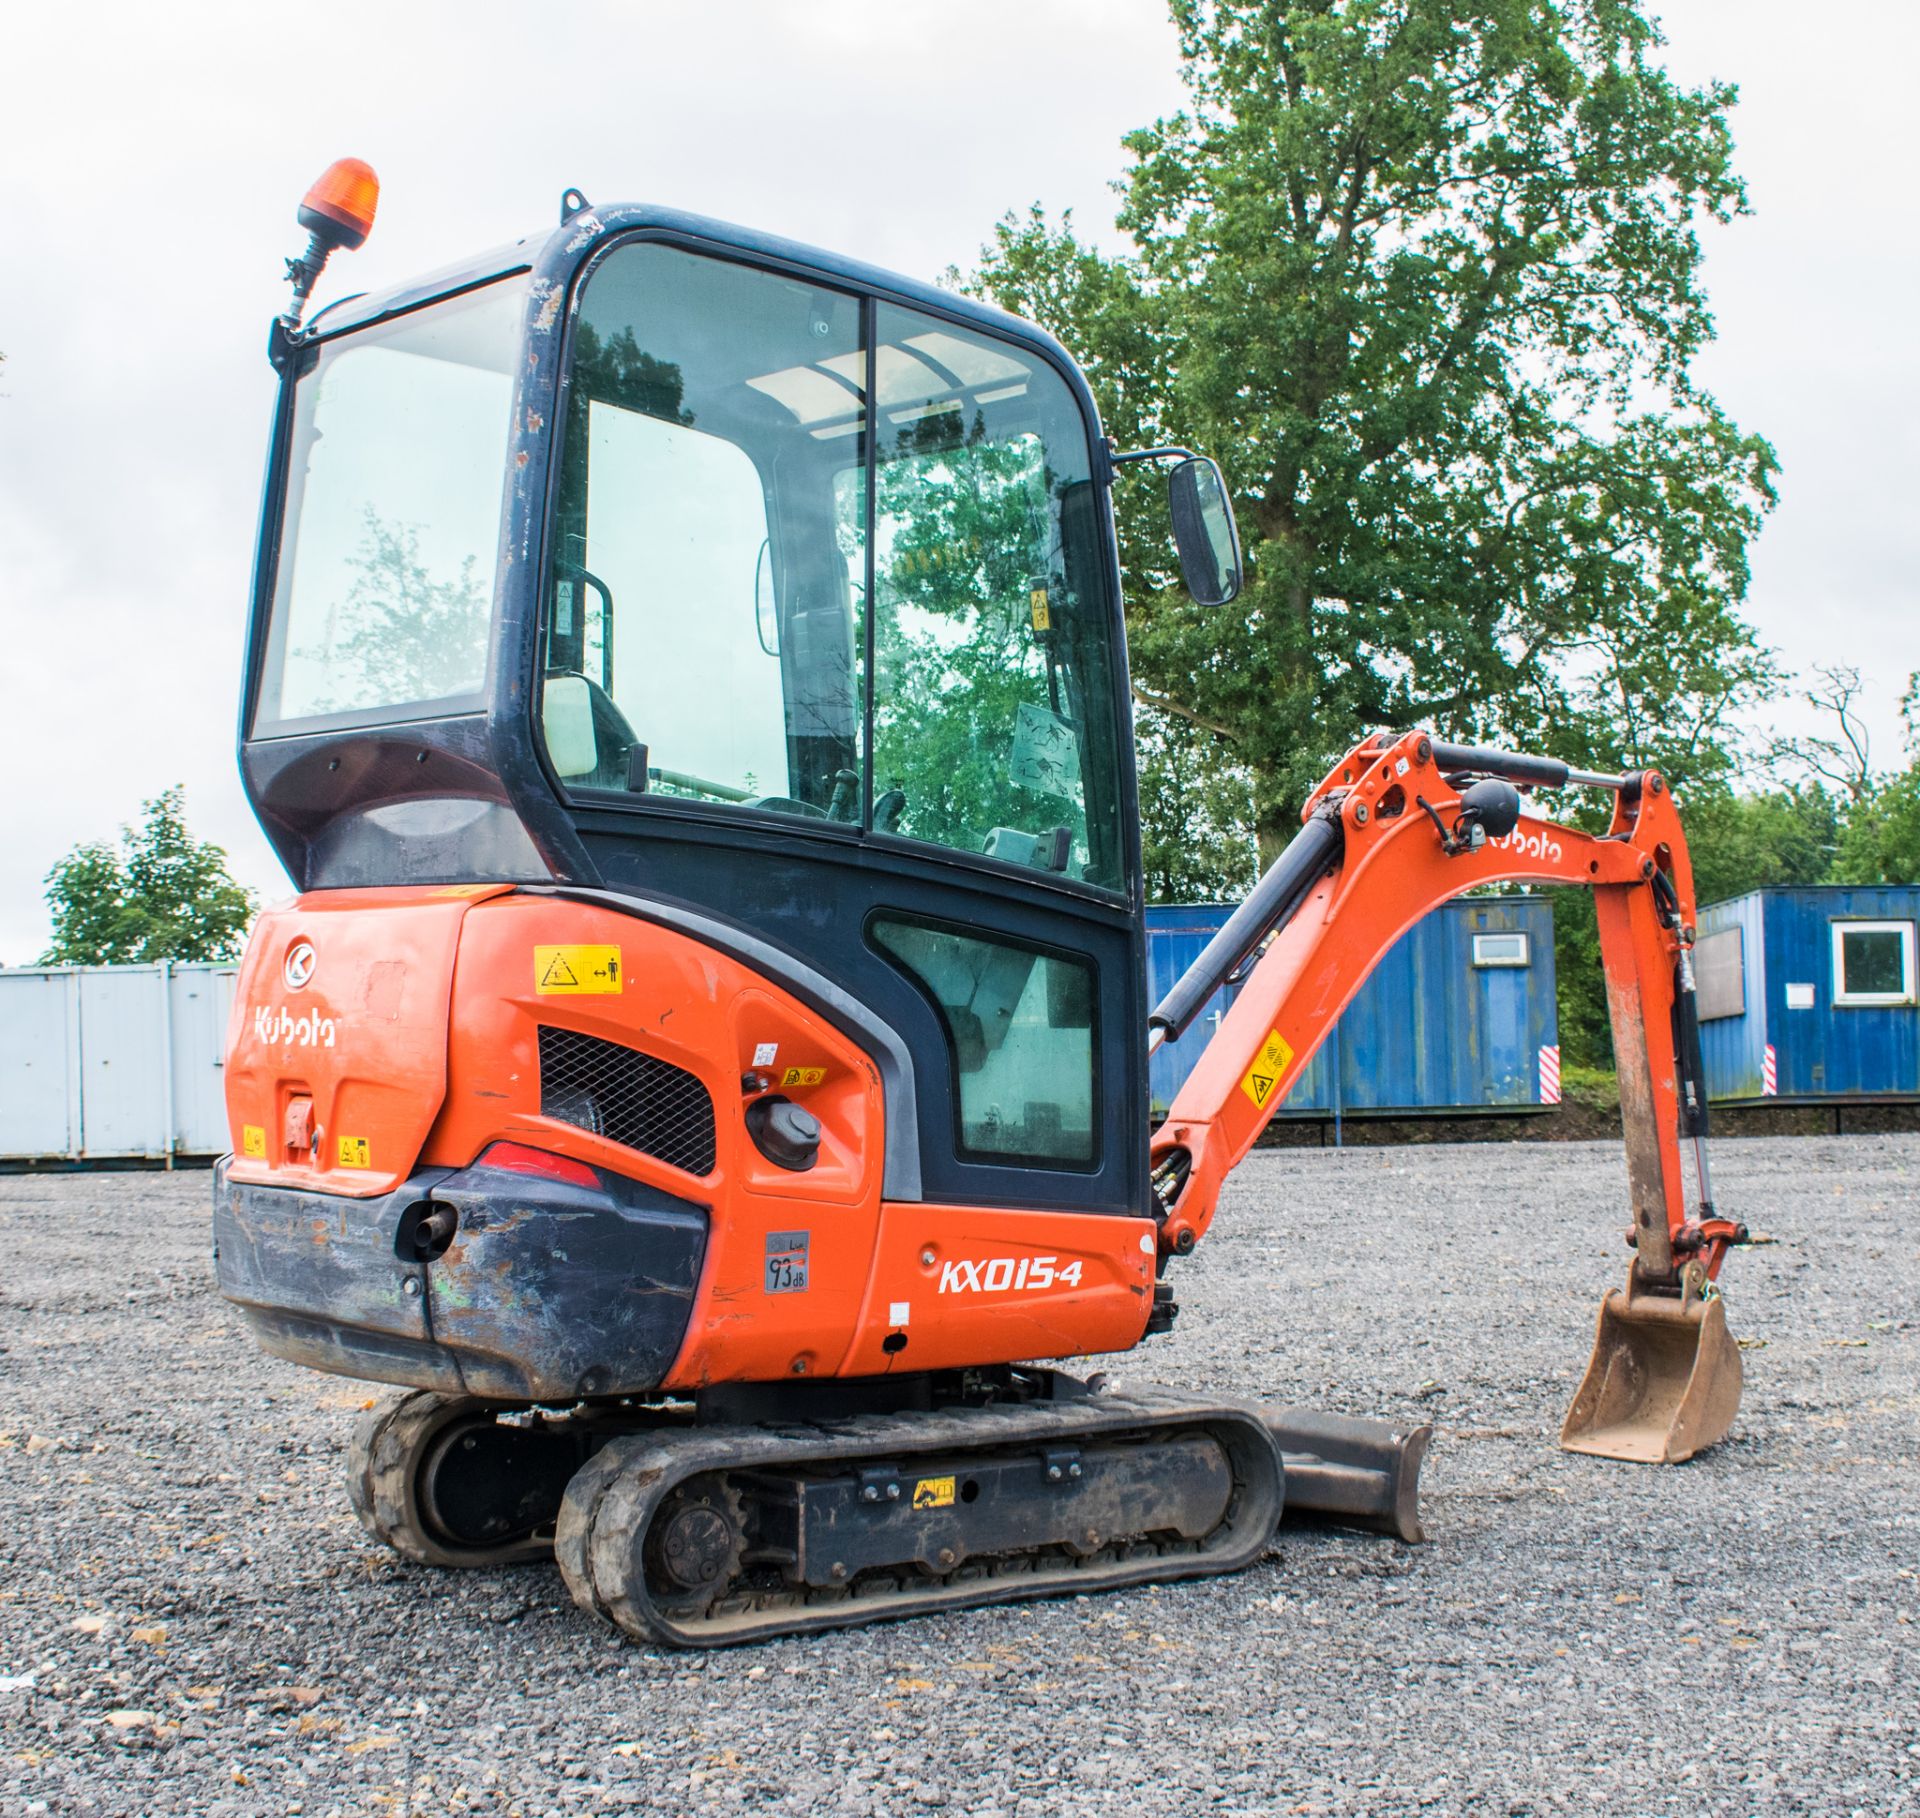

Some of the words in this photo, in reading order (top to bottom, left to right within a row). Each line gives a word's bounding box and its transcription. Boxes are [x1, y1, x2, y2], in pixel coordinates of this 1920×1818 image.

[255, 1005, 335, 1048] Kubota
[769, 1257, 792, 1289] 93
[792, 1271, 805, 1287] dB
[938, 1257, 1083, 1294] KX015-4
